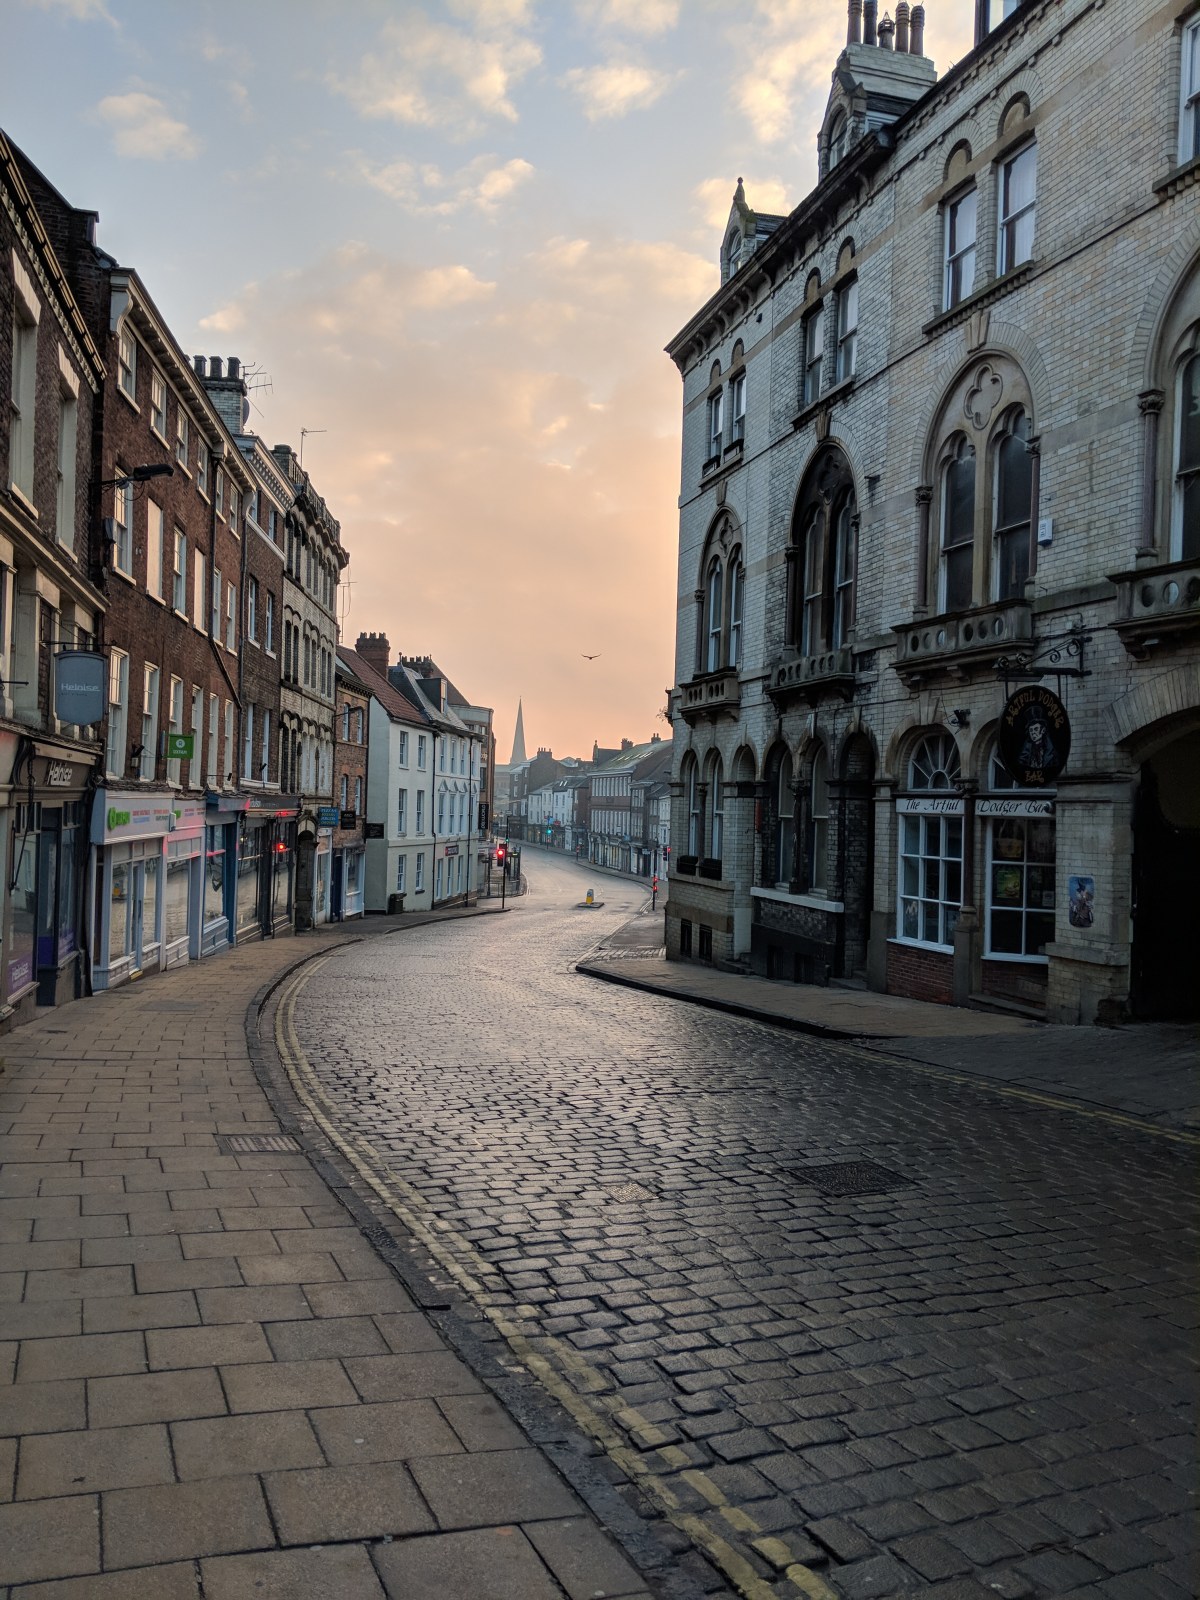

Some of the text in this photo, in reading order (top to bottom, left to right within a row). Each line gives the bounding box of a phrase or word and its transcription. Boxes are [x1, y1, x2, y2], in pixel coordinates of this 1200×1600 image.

[1006, 690, 1064, 729] ARTFUL DODGER
[1025, 770, 1045, 783] BAR
[905, 798, 960, 813] The Artful
[976, 799, 1023, 815] Dodger
